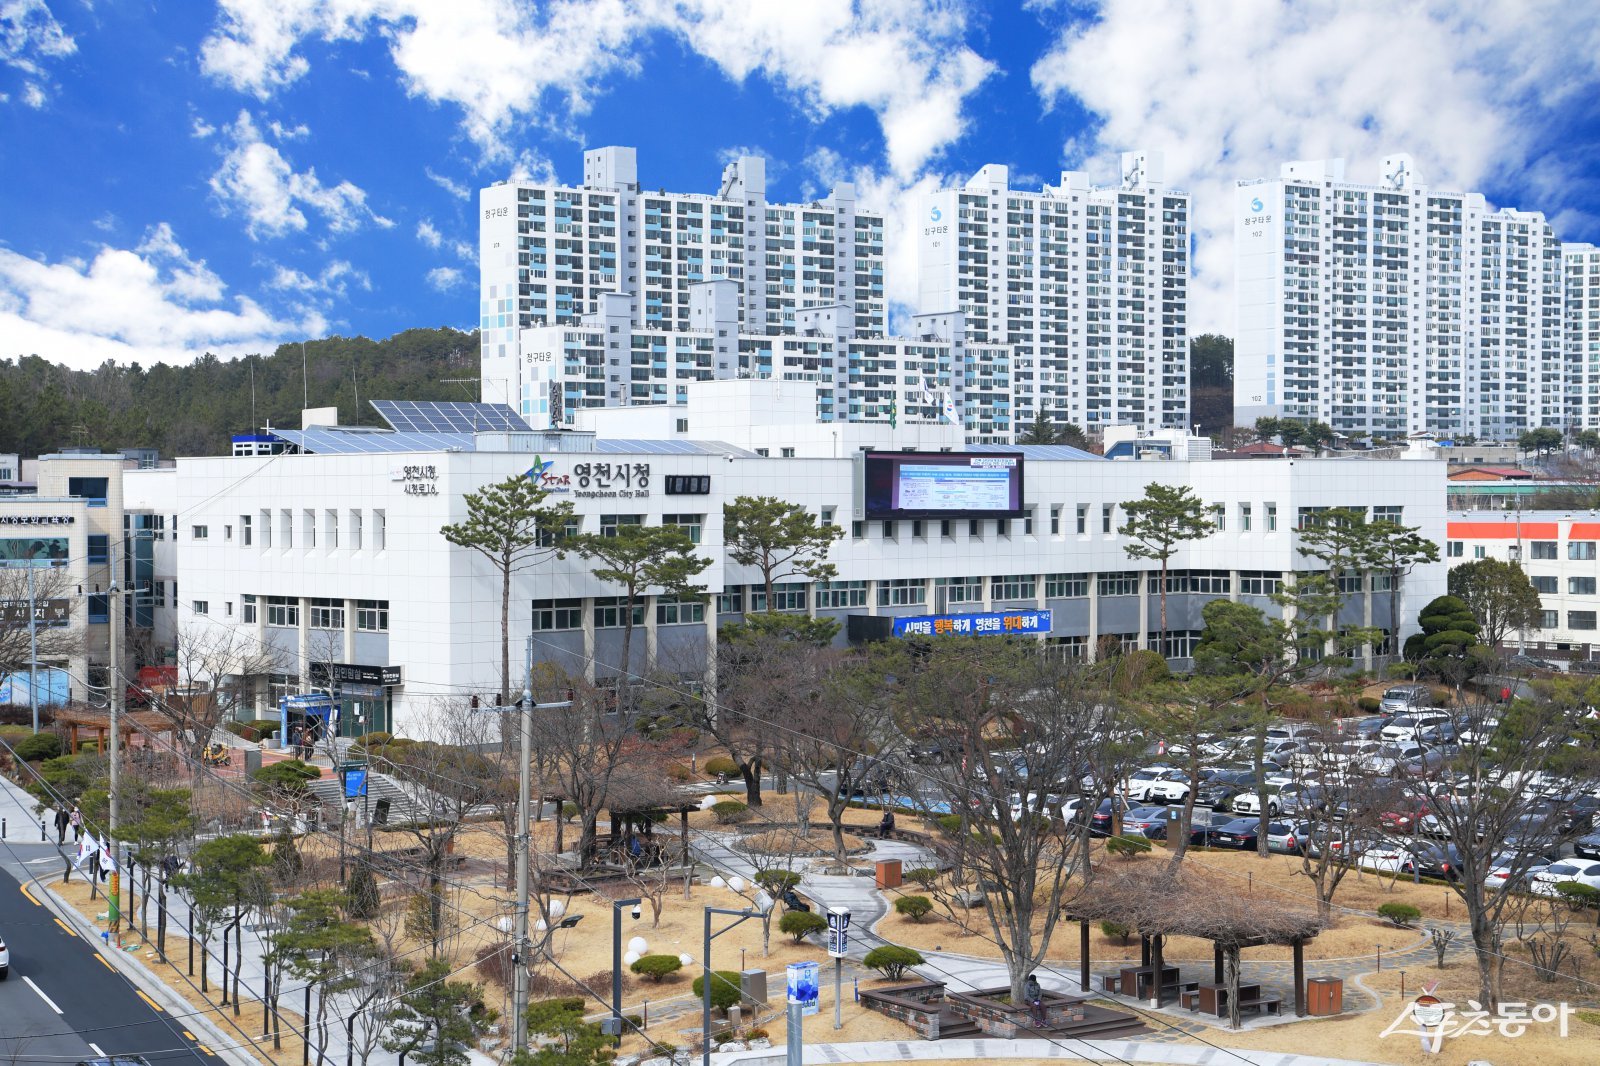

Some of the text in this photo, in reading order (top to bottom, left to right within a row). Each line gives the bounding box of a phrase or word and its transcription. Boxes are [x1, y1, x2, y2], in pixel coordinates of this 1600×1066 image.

[485, 206, 508, 219] 청구타운
[1244, 215, 1271, 226] 청구타운
[526, 351, 552, 363] 청구타운
[403, 465, 436, 480] 영천시청
[573, 463, 651, 488] 영천시청
[403, 483, 436, 495] 시청로 16
[574, 490, 650, 499] Yeongcheon City Hall
[904, 615, 1038, 634] 시민을 행복하게 영천을 위대하게
